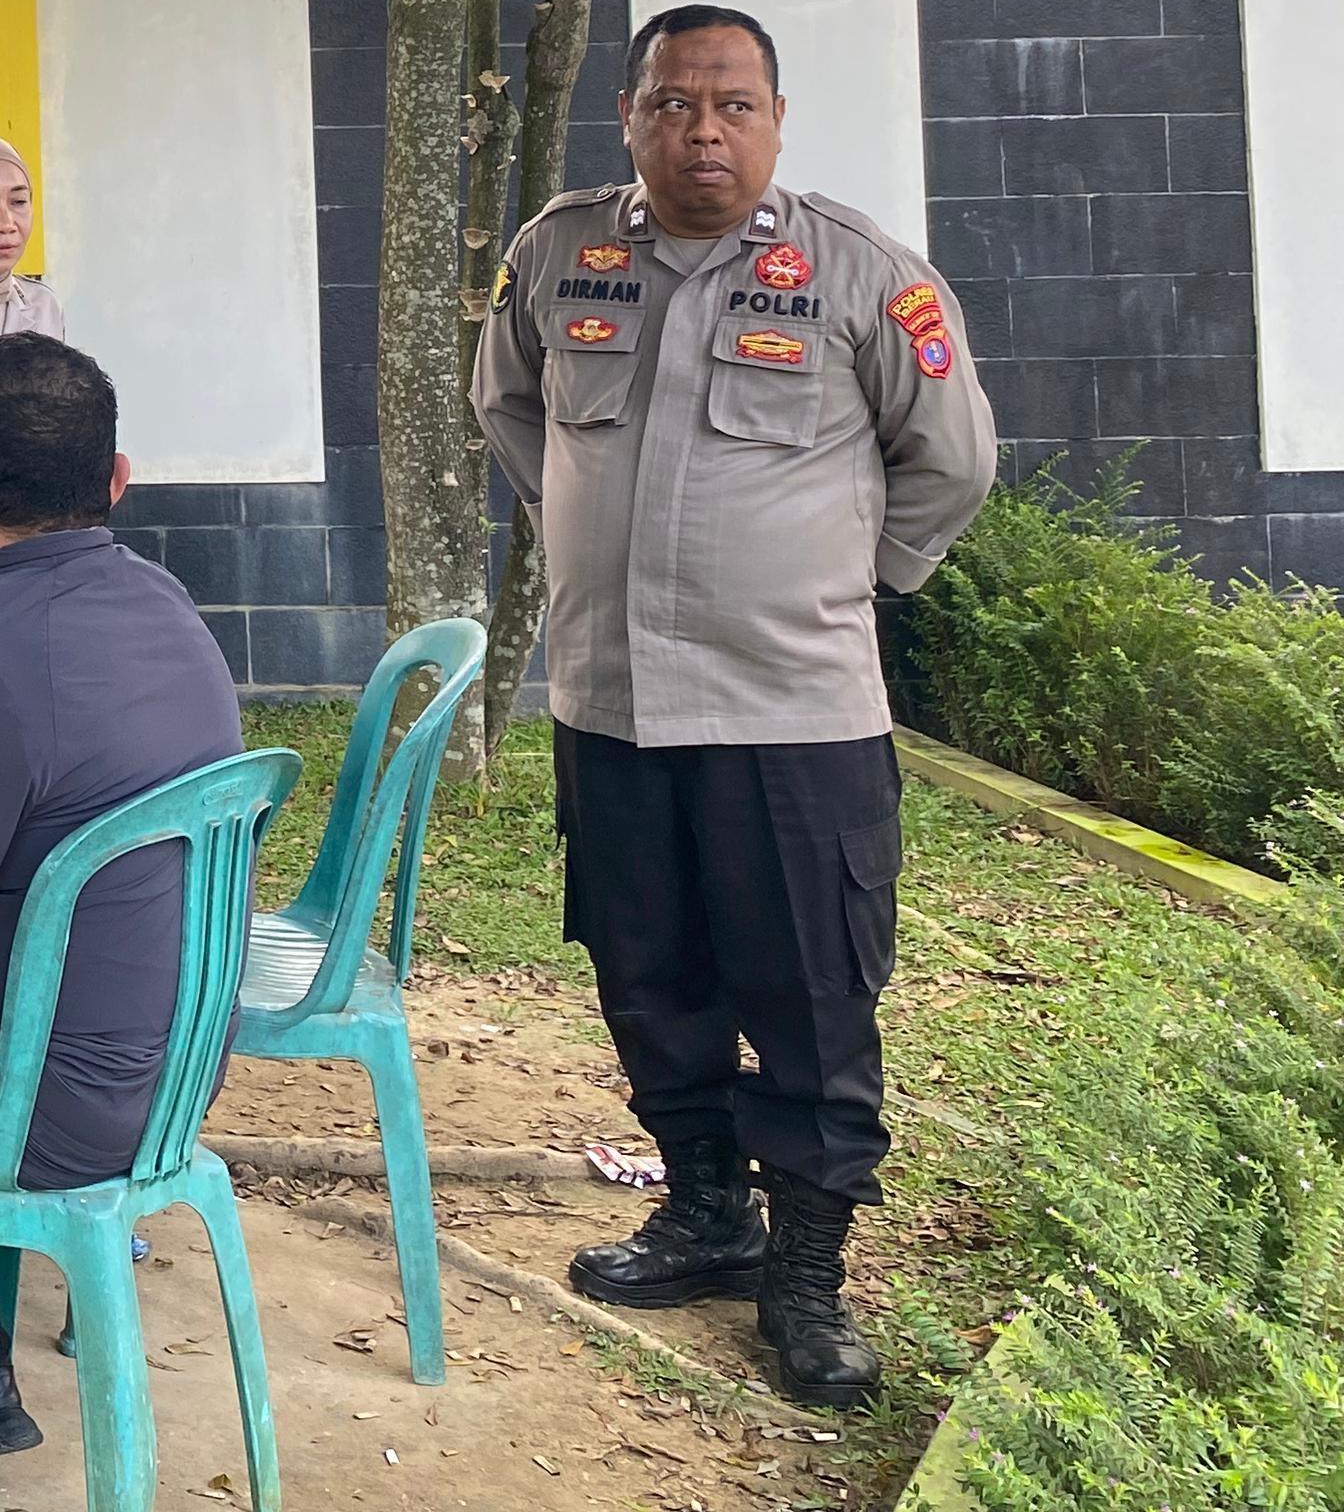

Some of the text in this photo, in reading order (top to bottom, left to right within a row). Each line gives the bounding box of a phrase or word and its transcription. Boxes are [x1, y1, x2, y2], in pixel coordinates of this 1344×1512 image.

[556, 278, 640, 303] DIRMAN
[729, 290, 820, 318] POLRI
[892, 285, 934, 315] POLRES
